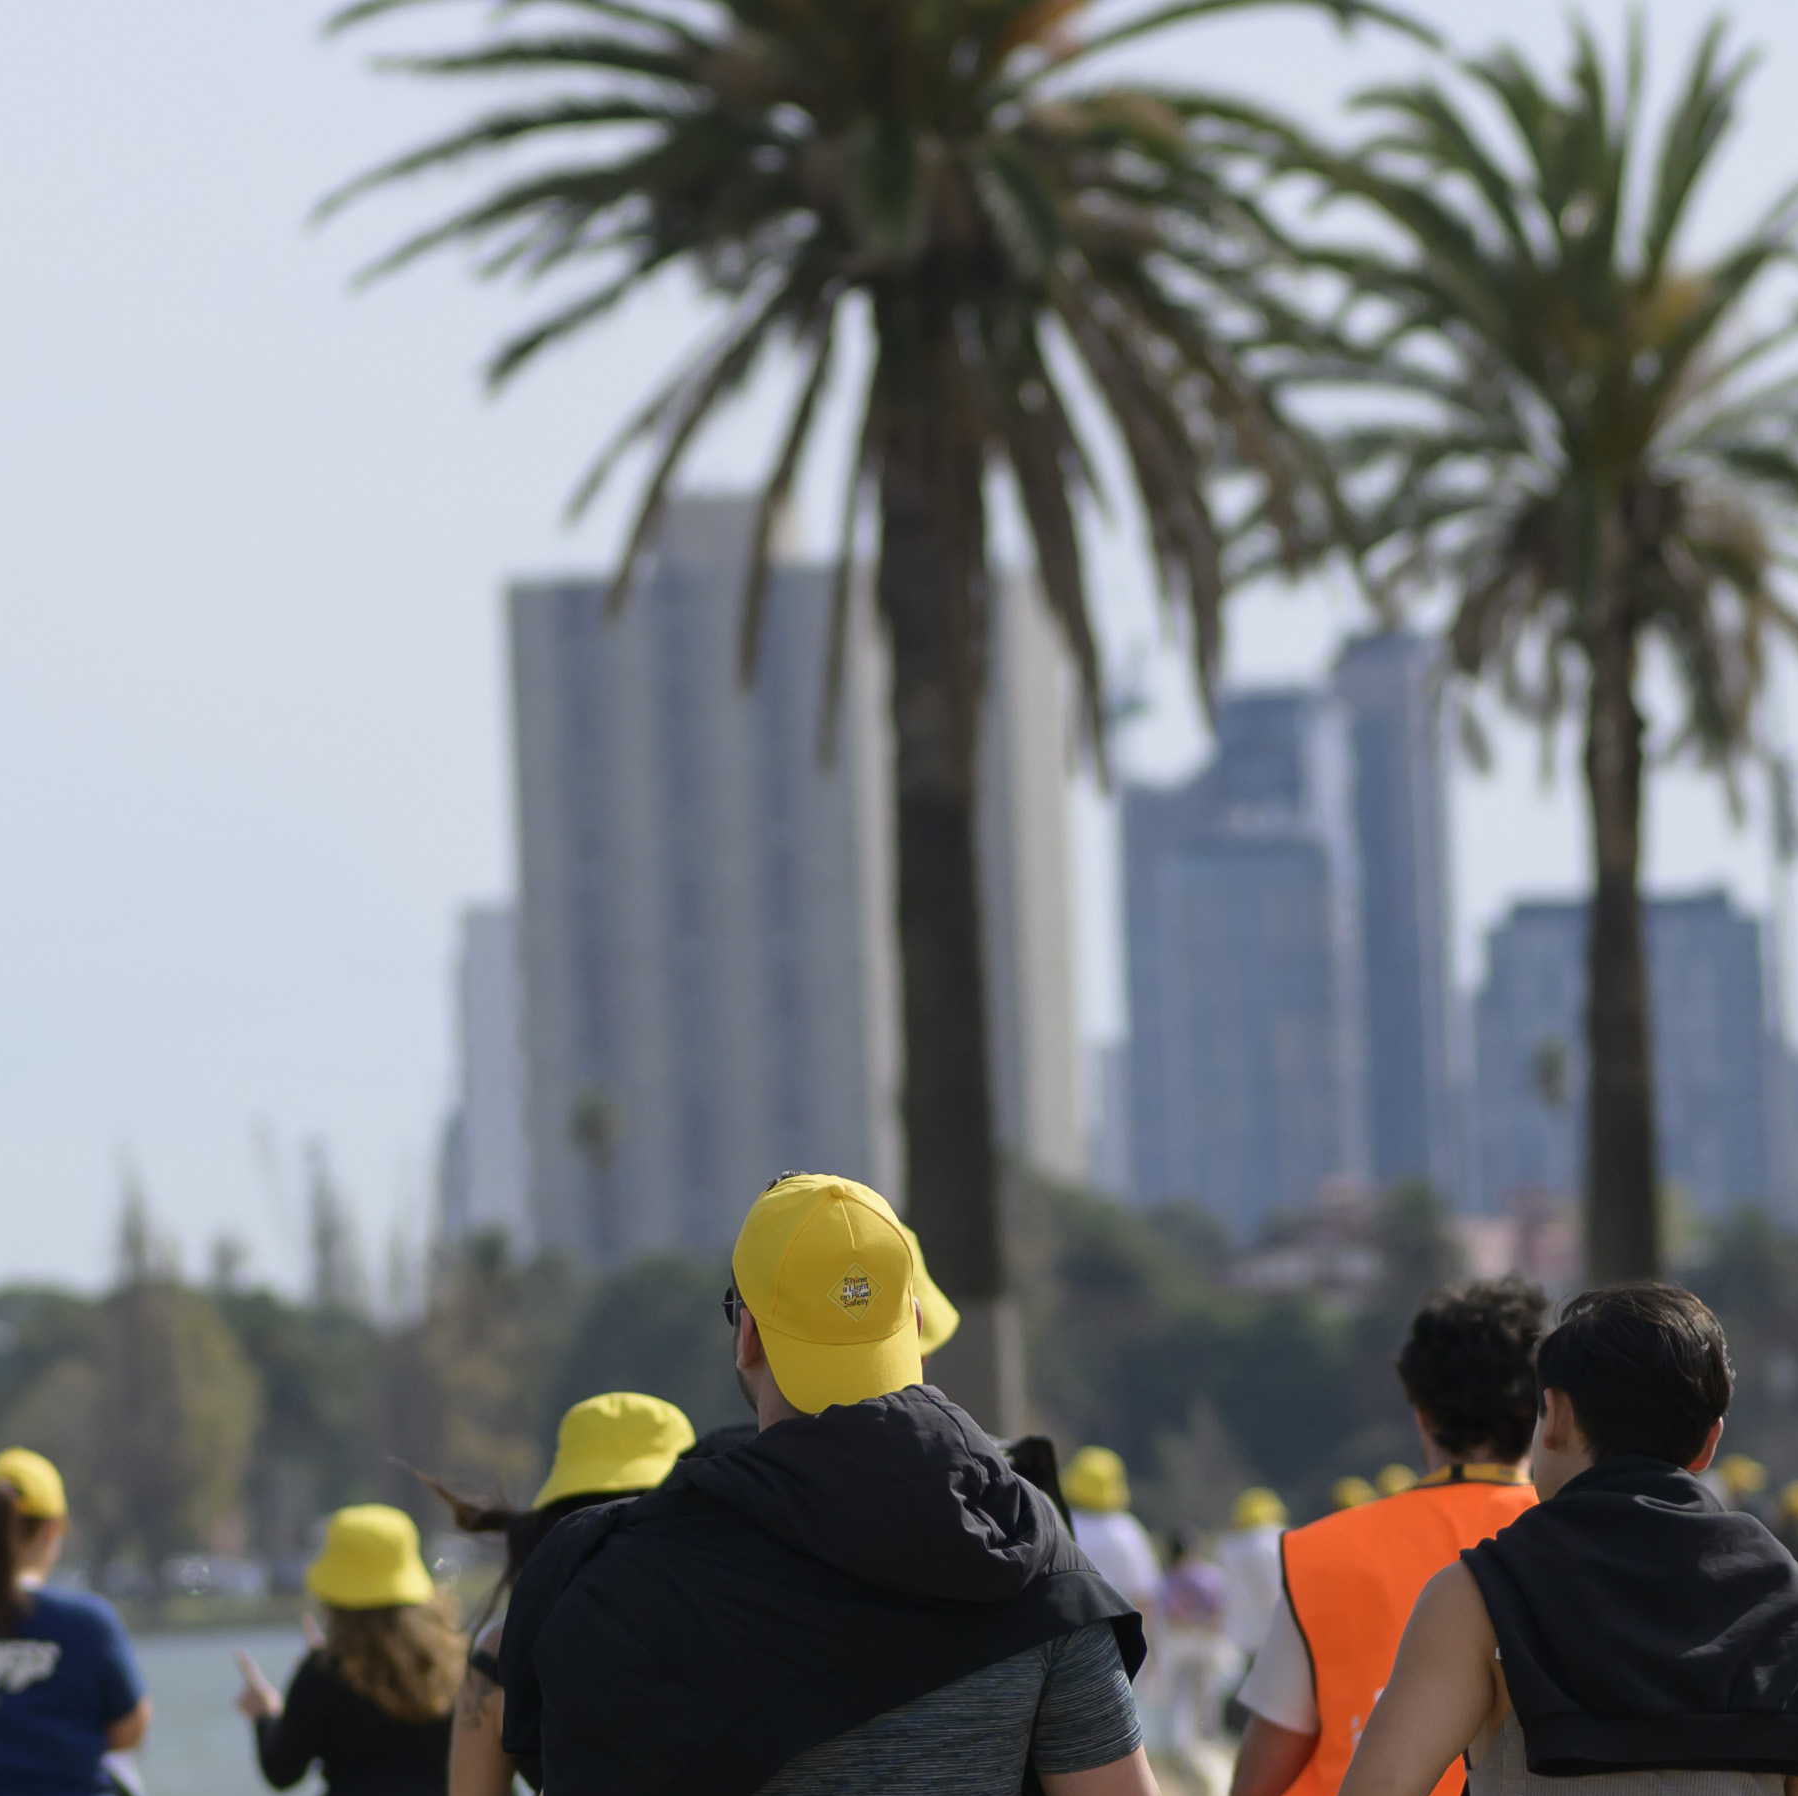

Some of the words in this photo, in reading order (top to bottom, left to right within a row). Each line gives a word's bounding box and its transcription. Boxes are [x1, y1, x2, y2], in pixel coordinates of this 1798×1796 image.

[844, 1276, 867, 1285] Shine
[852, 1288, 871, 1299] Road
[844, 1298, 868, 1308] Safety
